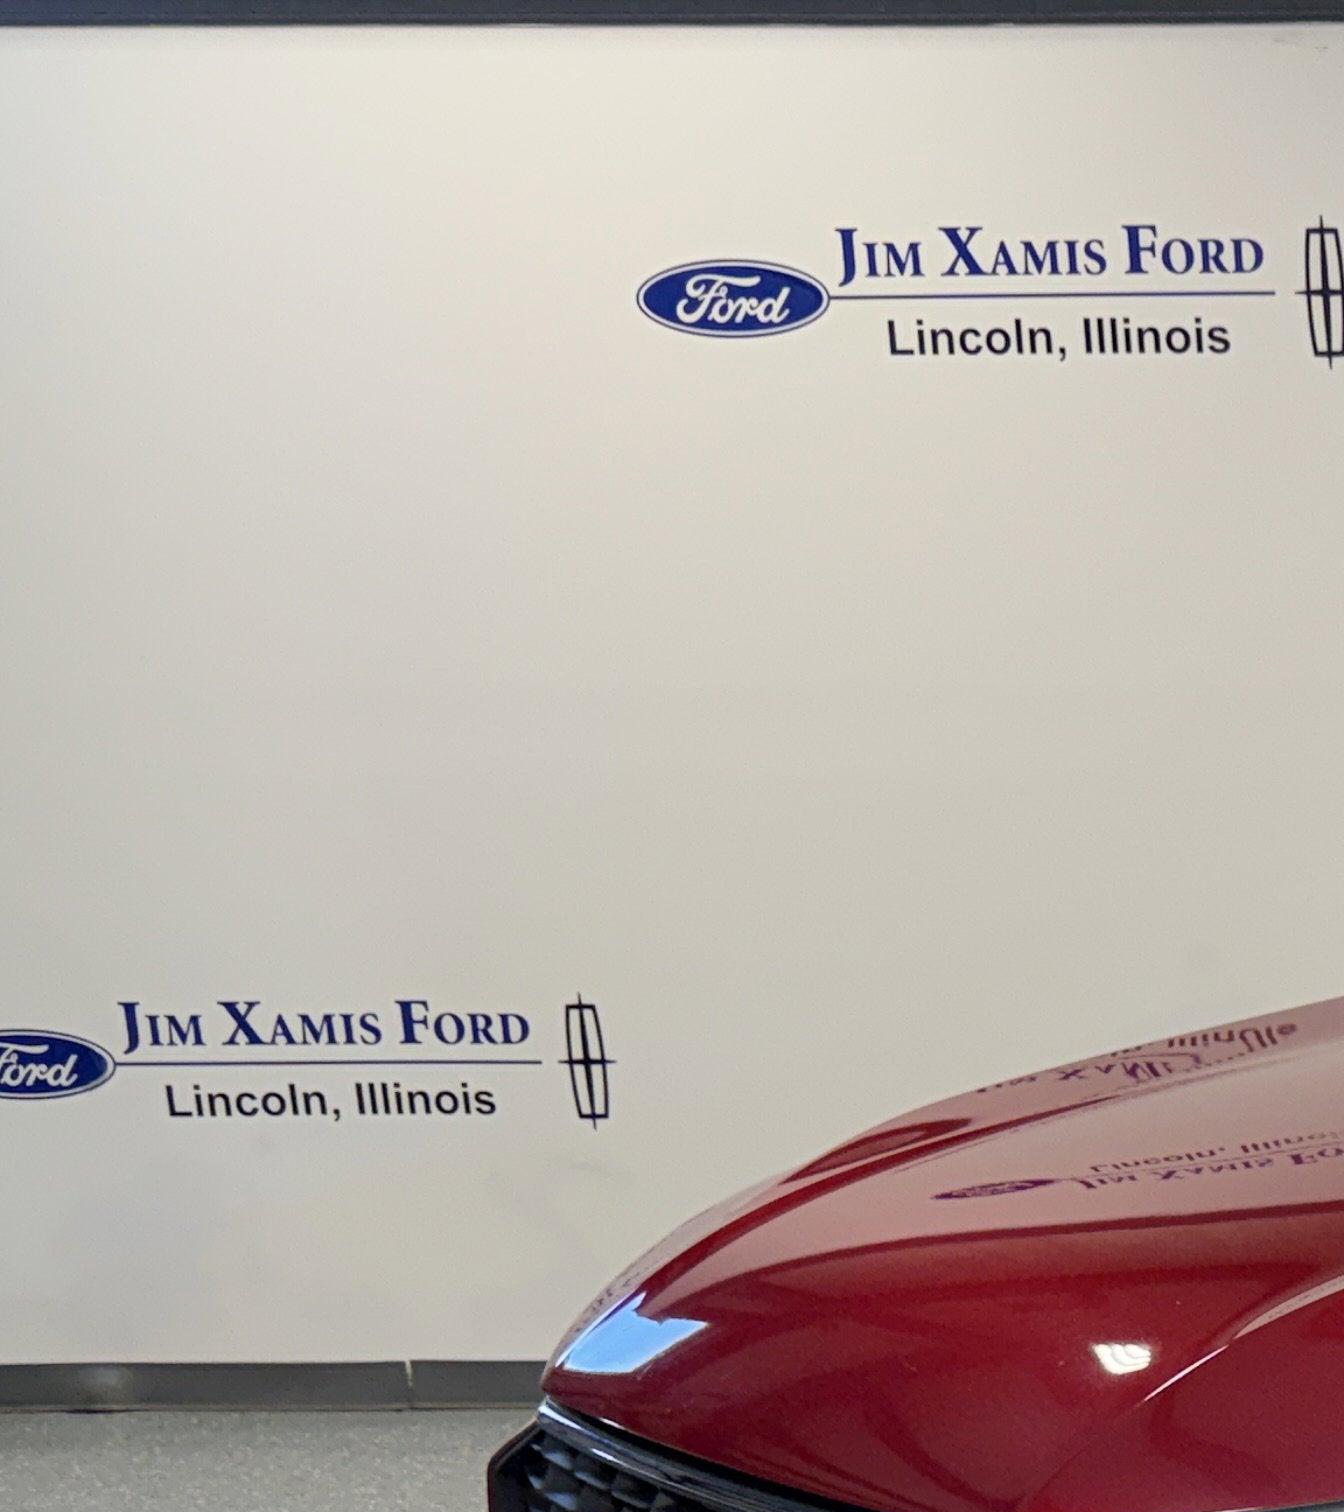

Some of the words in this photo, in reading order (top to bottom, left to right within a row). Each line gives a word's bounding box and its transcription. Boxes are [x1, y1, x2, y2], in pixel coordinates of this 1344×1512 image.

[834, 228, 924, 288] JIM
[938, 226, 1107, 277] XAMIS
[1121, 225, 1264, 275] FORD
[675, 273, 791, 325] Ford
[887, 319, 1067, 362] Lincoln,
[1083, 316, 1231, 354] Illinois
[117, 1001, 206, 1054] JIM
[217, 1001, 382, 1046] XAMIS
[394, 1000, 530, 1045] FORD
[166, 1083, 341, 1121] Lincoln,
[355, 1082, 497, 1115] Illinois
